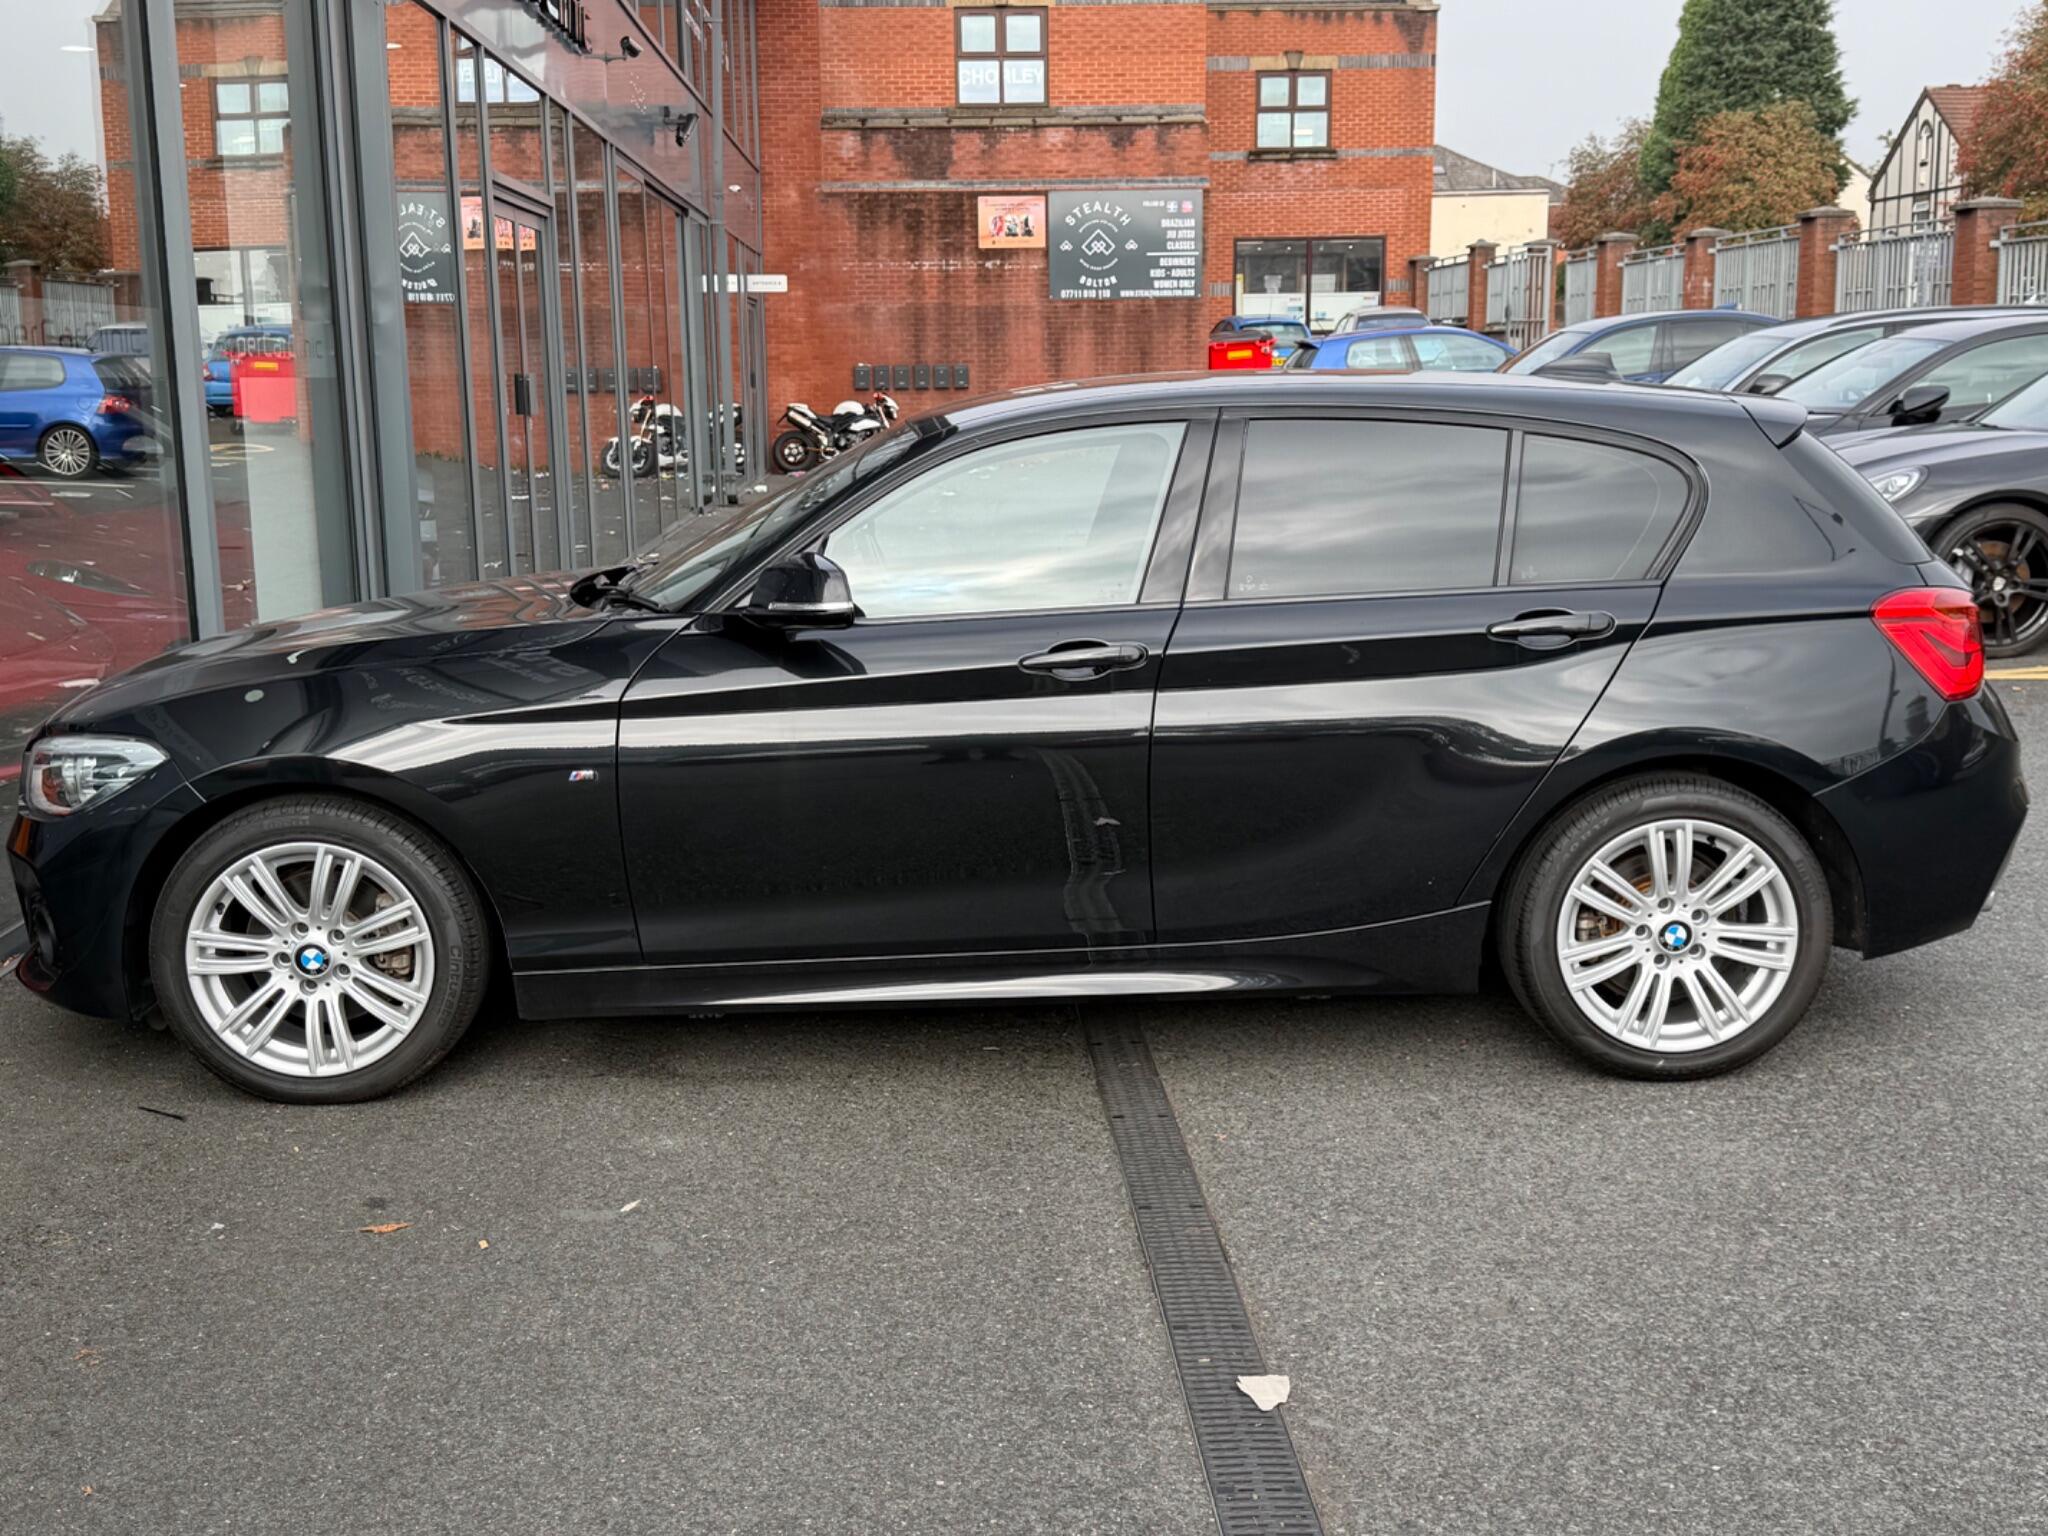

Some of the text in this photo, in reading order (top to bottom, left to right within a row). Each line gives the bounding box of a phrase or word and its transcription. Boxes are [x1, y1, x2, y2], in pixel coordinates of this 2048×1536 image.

[961, 67, 1043, 85] CHOLEY
[1065, 200, 1132, 226] STEALTH
[1161, 218, 1195, 228] BRAZILIAN
[1166, 241, 1195, 250] CLASSES
[1159, 257, 1195, 266] BEGINNERS
[1150, 268, 1166, 278] KIDS
[1171, 268, 1195, 277] ADULTS
[1079, 275, 1118, 287] BOLTON
[1153, 279, 1195, 288] WOMEN ONLY
